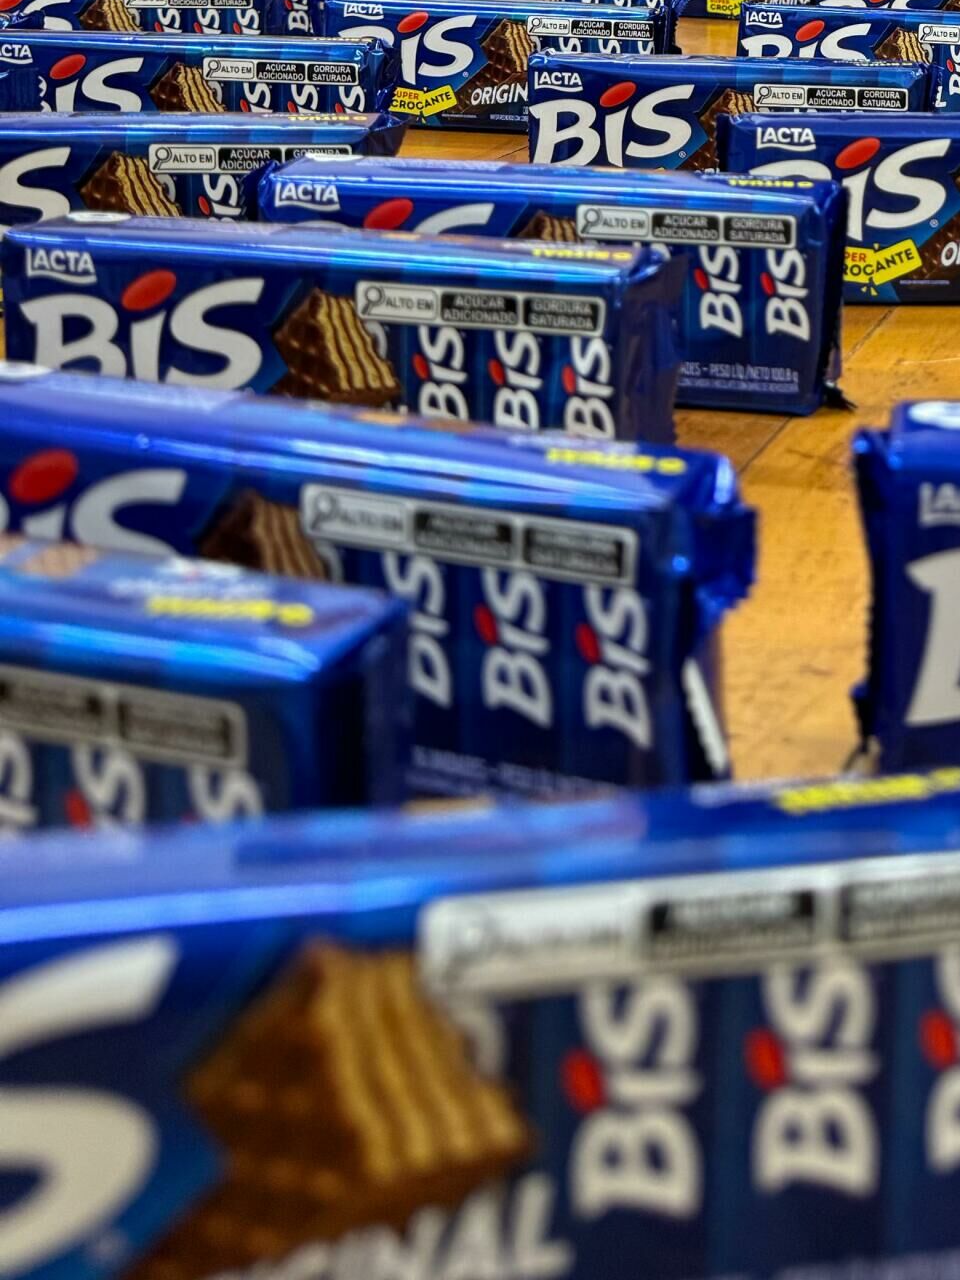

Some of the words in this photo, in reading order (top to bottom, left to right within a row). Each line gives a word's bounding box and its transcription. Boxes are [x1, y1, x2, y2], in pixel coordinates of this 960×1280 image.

[344, 3, 385, 19] LACTA
[746, 10, 783, 28] LACTA
[542, 22, 558, 31] ALTO
[559, 23, 568, 31] EM
[572, 27, 611, 36] ADICIONADO
[617, 29, 651, 38] SATURADA
[618, 22, 650, 30] GORDURA
[933, 30, 947, 39] ALTO
[948, 31, 958, 39] EM
[220, 65, 238, 74] ALTO
[239, 65, 252, 74] EM
[258, 71, 304, 81] ADICIONADO
[313, 64, 351, 74] GORDURA
[311, 73, 353, 83] SATURADA
[534, 71, 583, 92] LACTA
[391, 91, 452, 110] CROCANTE
[470, 82, 529, 106] ORIGIN
[770, 90, 792, 101] ALTO
[793, 91, 804, 101] EM
[863, 90, 902, 100] GORDURA
[808, 97, 855, 108] ADICIONADO
[862, 99, 903, 109] SATURADA
[528, 81, 696, 169] BiS
[757, 126, 816, 151] LACTA
[172, 153, 195, 164] ALTO
[198, 154, 214, 164] EM
[276, 182, 340, 211] LACTA
[601, 218, 631, 231] ALTO
[632, 218, 648, 231] EM
[730, 218, 785, 231] GORDURA
[653, 226, 719, 241] ADICIONADO
[728, 229, 787, 244] SATURADA
[26, 249, 98, 284] LACTA
[694, 246, 742, 339] BiS
[760, 250, 811, 341] BiS
[384, 295, 416, 312] ALTO
[417, 296, 436, 313] EM
[530, 299, 594, 315] GORDURA
[443, 307, 519, 324] ADICIONADO
[527, 313, 596, 330] SATURADA
[20, 270, 265, 392] BiS
[474, 568, 553, 727] BiS
[575, 583, 655, 750] BiS
[746, 957, 881, 1197] BiS
[562, 975, 706, 1220] BiS
